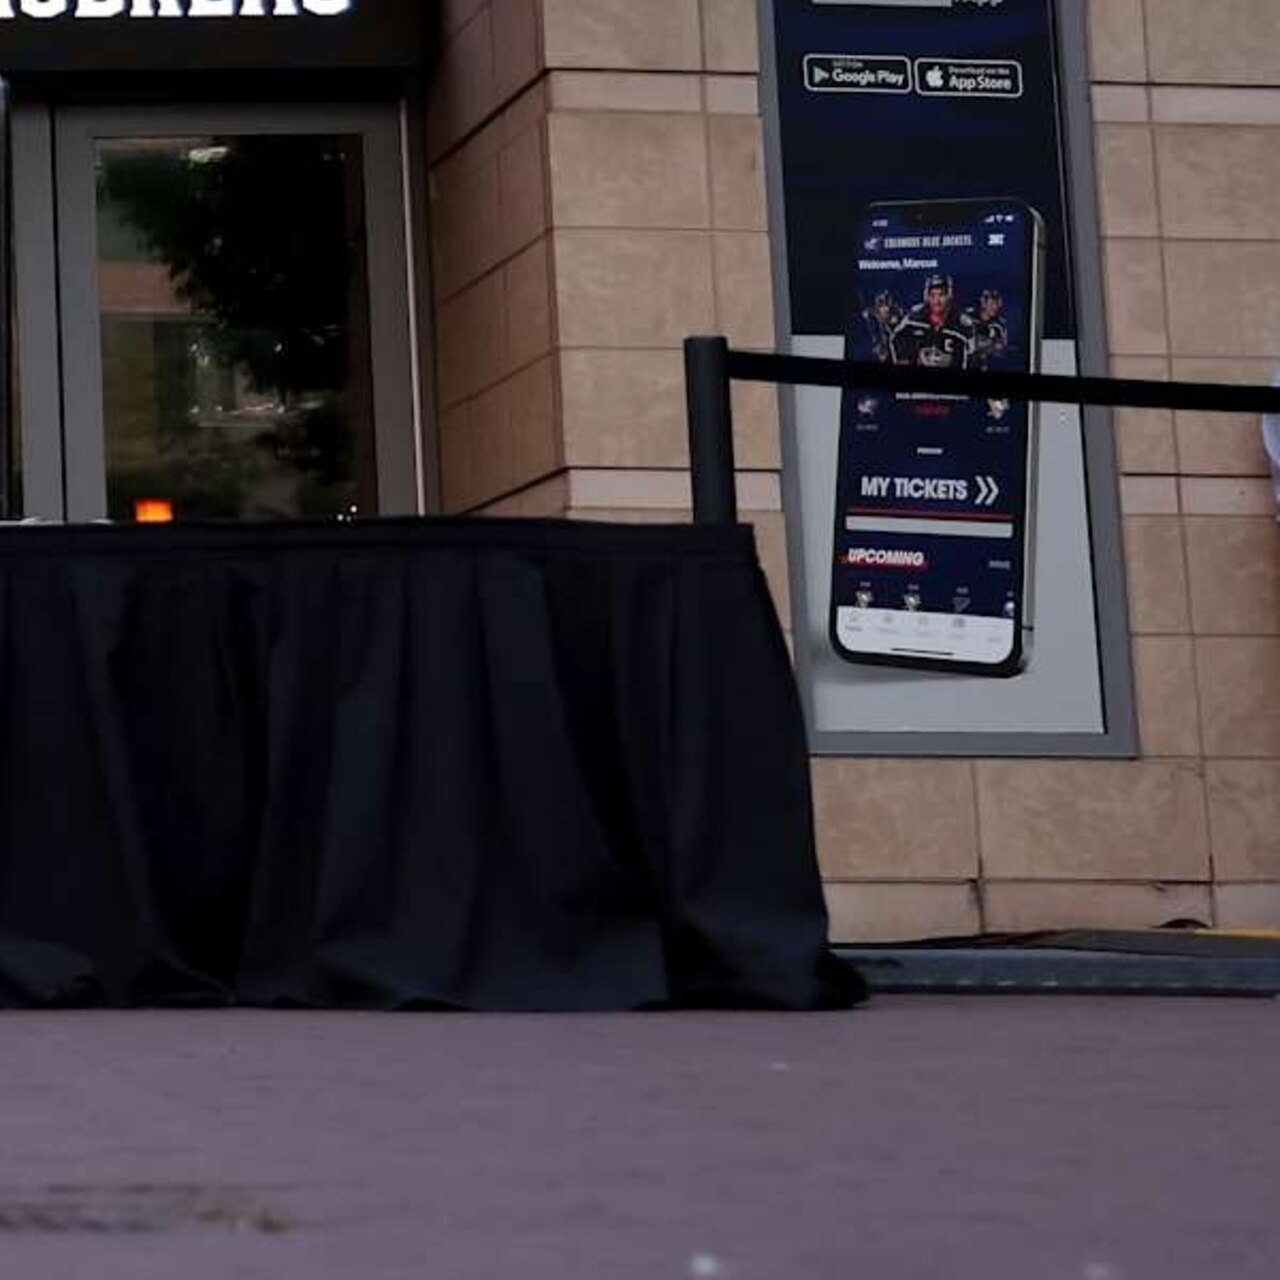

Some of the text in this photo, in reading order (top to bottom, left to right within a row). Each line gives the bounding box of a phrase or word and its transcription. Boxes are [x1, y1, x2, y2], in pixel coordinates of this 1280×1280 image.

[860, 475, 968, 501] MY TICKETS
[846, 547, 925, 568] UPCOMING
